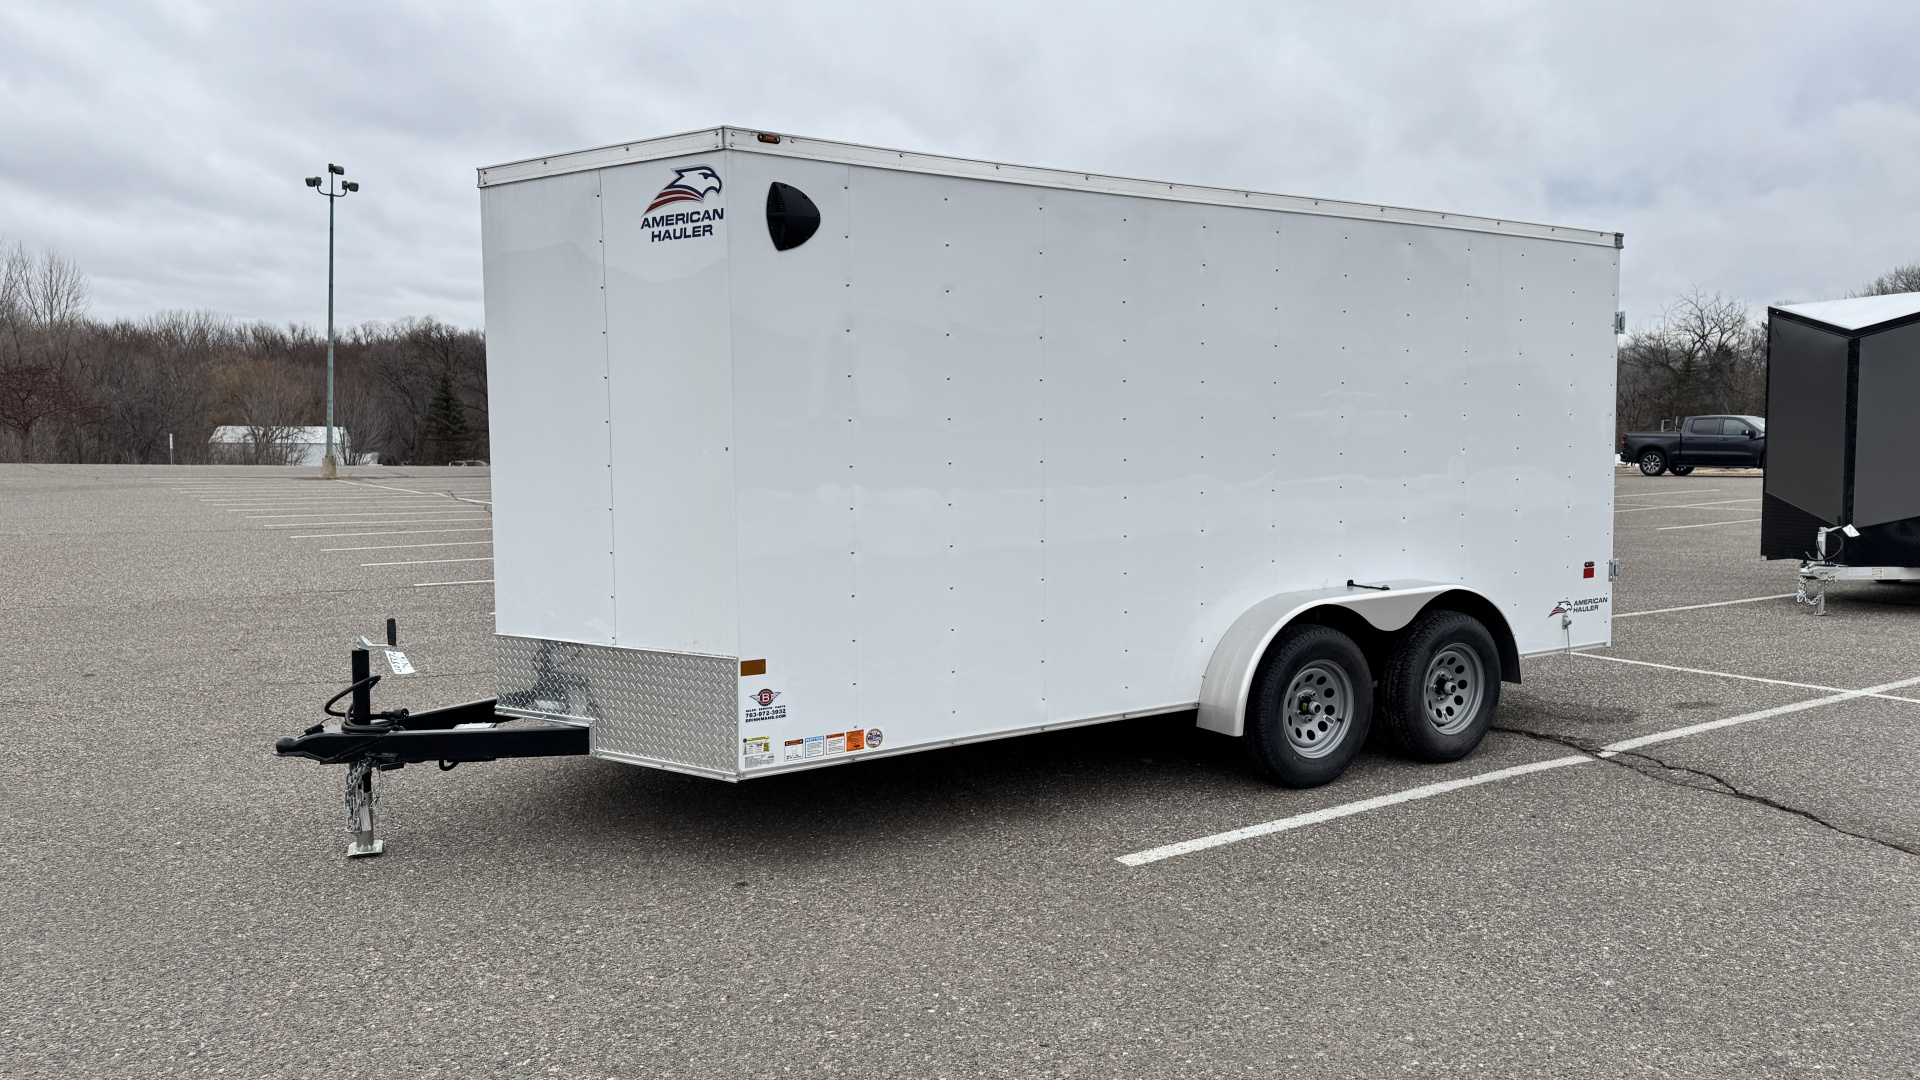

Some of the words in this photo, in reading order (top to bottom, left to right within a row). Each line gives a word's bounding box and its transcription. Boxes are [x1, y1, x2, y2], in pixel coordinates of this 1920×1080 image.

[640, 207, 724, 229] AMERICAN
[651, 224, 713, 242] HAULER
[1573, 597, 1608, 606] AMERICAN
[1573, 605, 1599, 613] HAULER
